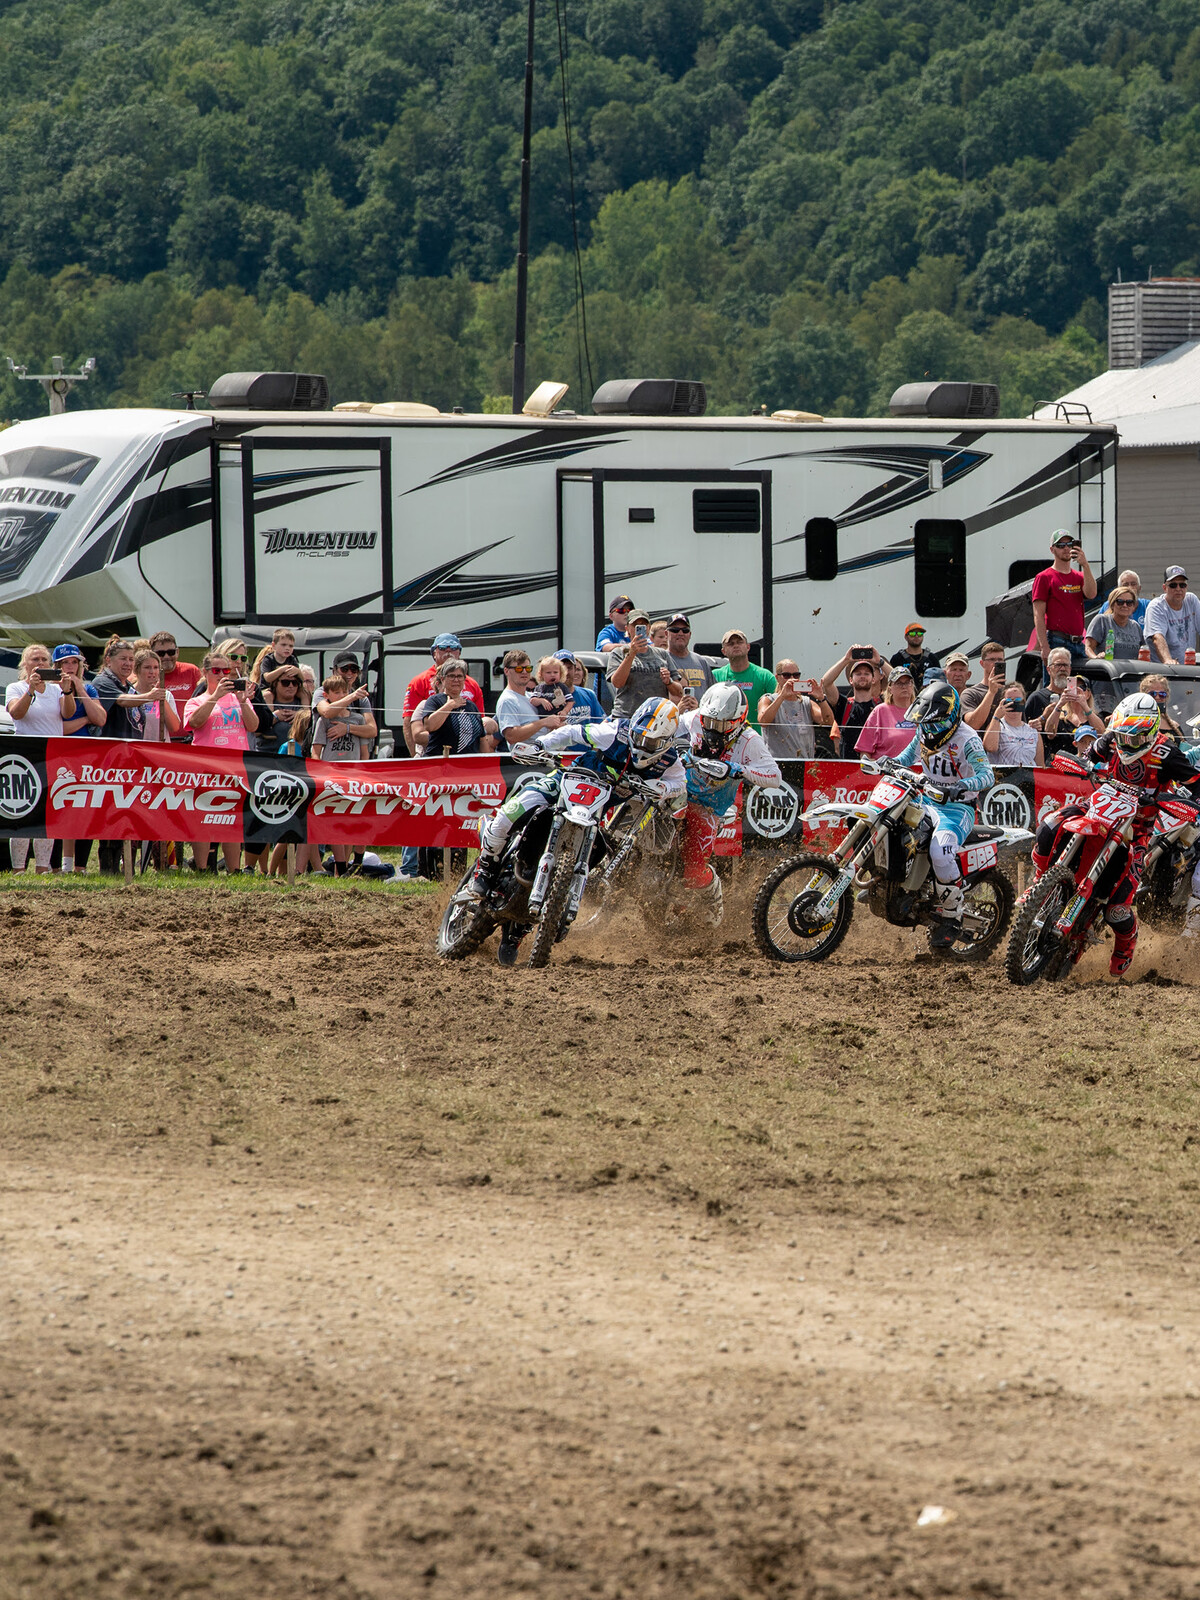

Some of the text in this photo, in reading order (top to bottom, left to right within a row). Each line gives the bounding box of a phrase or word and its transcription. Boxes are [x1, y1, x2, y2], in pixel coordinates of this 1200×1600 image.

[260, 528, 378, 554] MOMENTUM
[81, 764, 244, 788] ROCKY MOUNTAIN
[567, 782, 602, 806] 3
[1093, 794, 1133, 821] 212
[820, 874, 845, 908] DUNLOP
